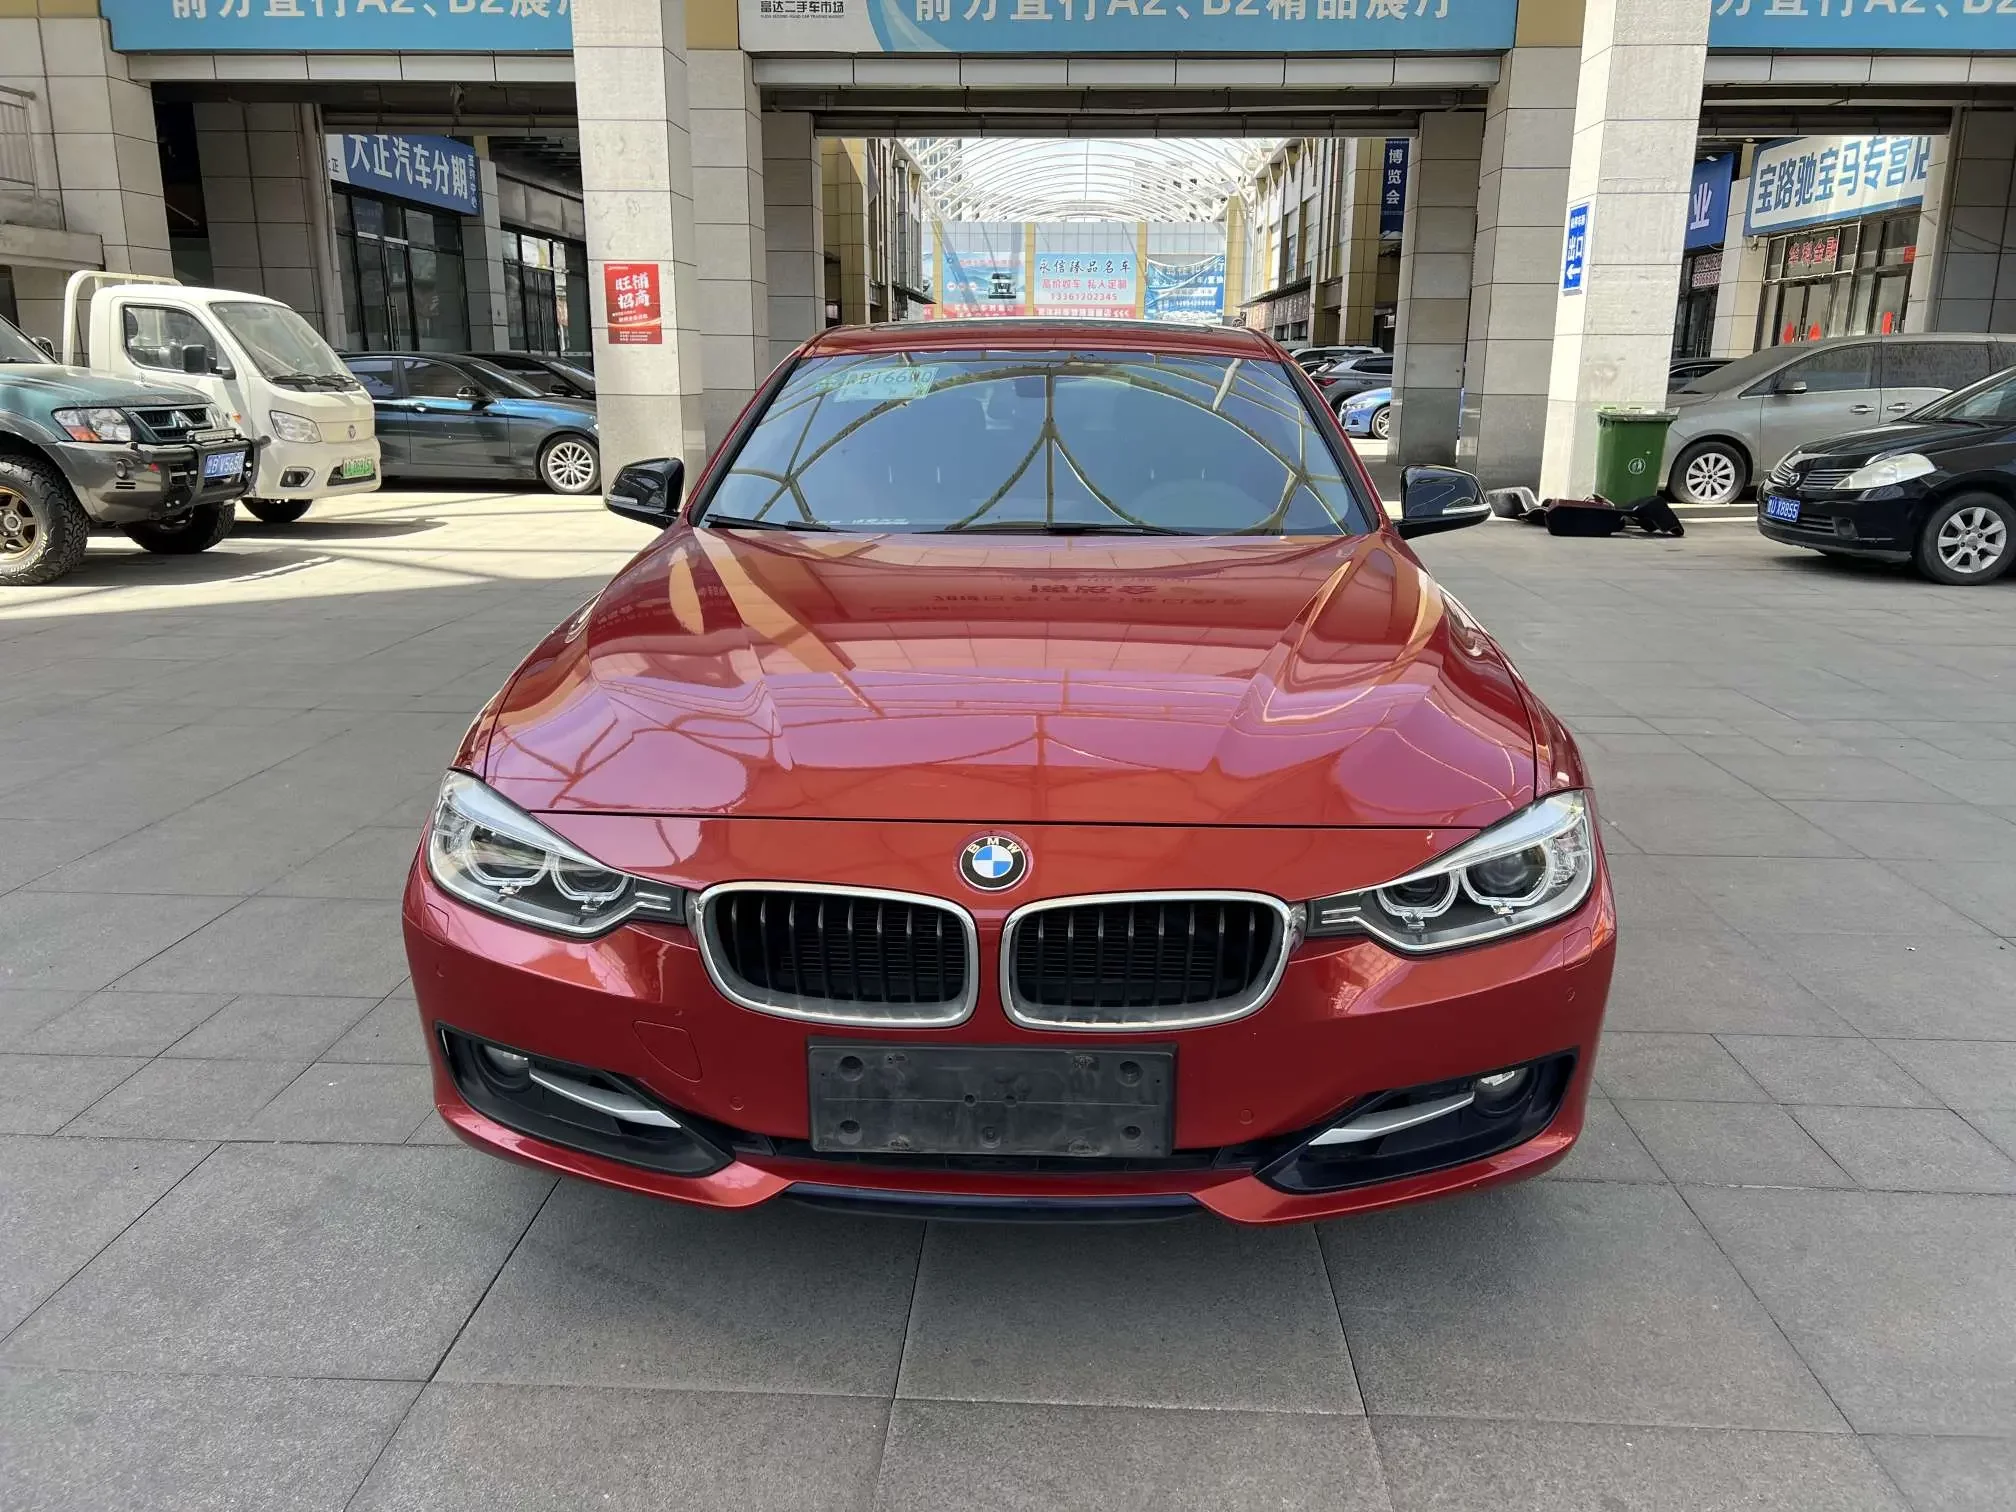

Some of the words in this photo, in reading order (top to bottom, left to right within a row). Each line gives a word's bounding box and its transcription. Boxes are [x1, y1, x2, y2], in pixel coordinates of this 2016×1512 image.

[348, 134, 468, 199] 大正汽车分期
[1386, 148, 1404, 205] 博览会
[1690, 182, 1712, 230] 业
[1567, 235, 1584, 262] 出口
[615, 272, 650, 291] 旺铺
[617, 290, 651, 310] 招商
[967, 837, 1021, 853] BMW
